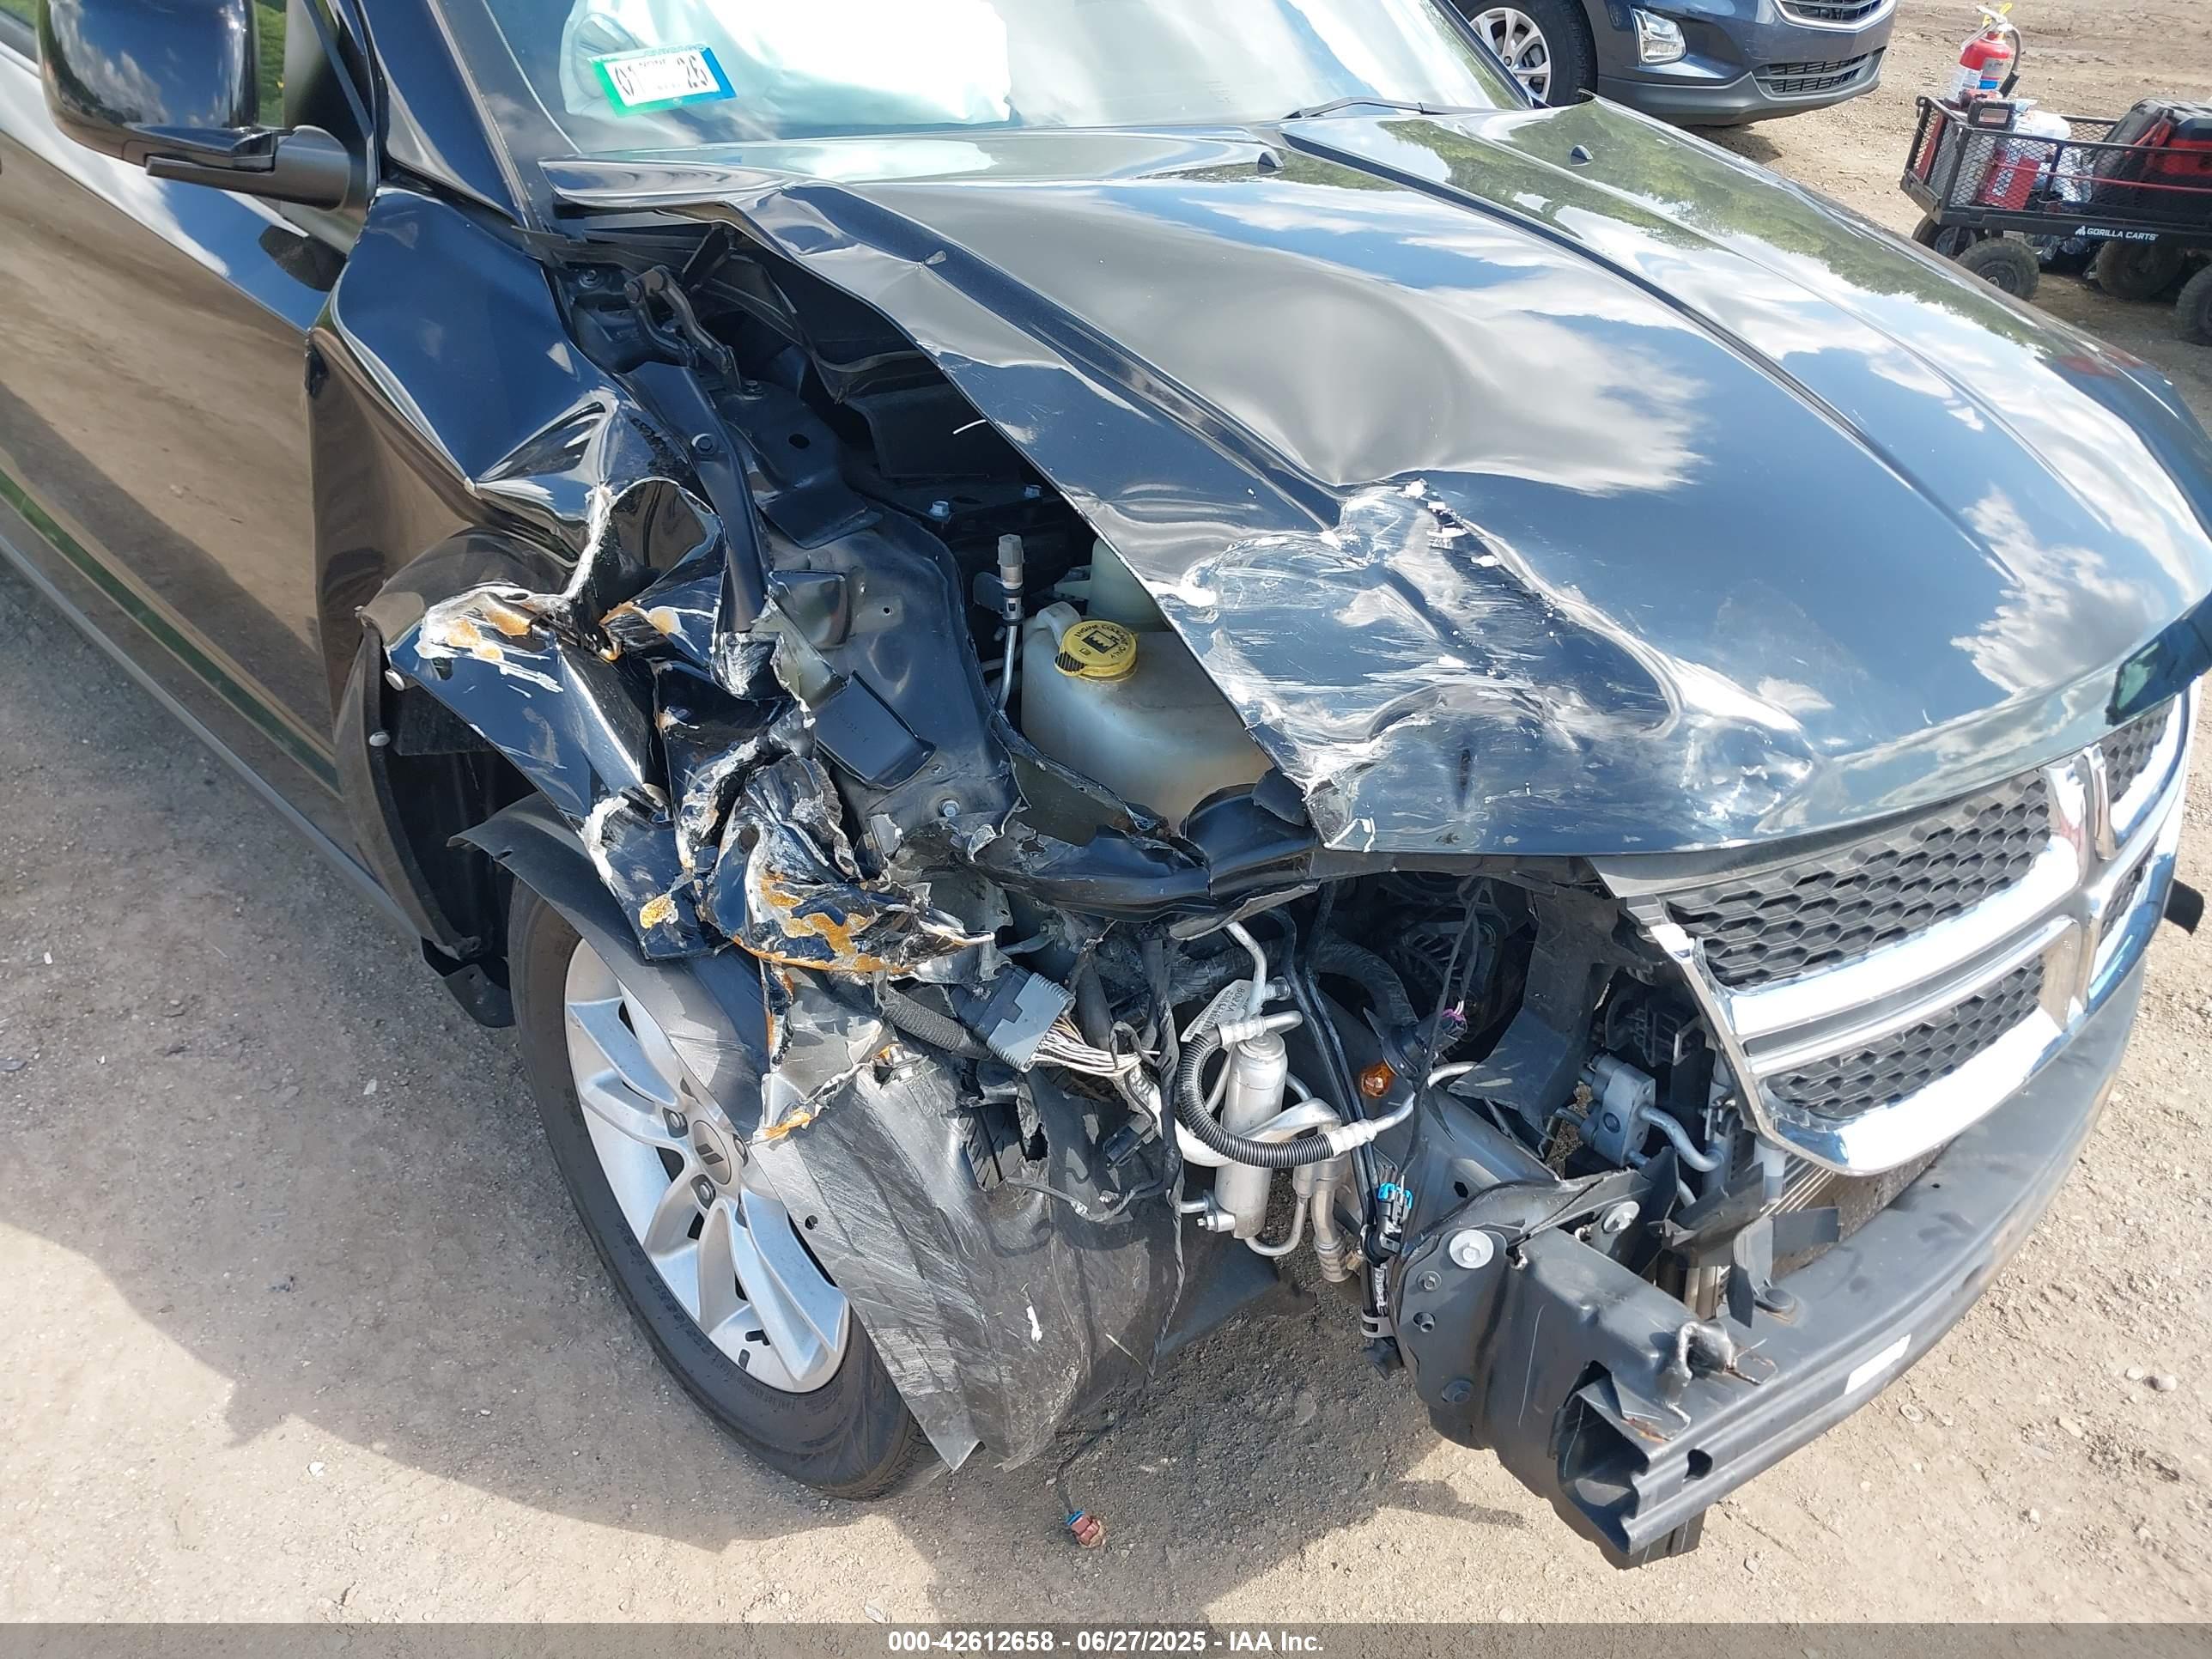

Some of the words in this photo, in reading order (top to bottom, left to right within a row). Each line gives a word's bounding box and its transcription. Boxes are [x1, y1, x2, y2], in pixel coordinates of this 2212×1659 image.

[2087, 227, 2124, 238] GORILLA
[2125, 231, 2157, 241] CARTS
[1073, 624, 1098, 638] ENGINE
[1101, 624, 1129, 647] COOLANT
[1109, 646, 1127, 659] ONLY
